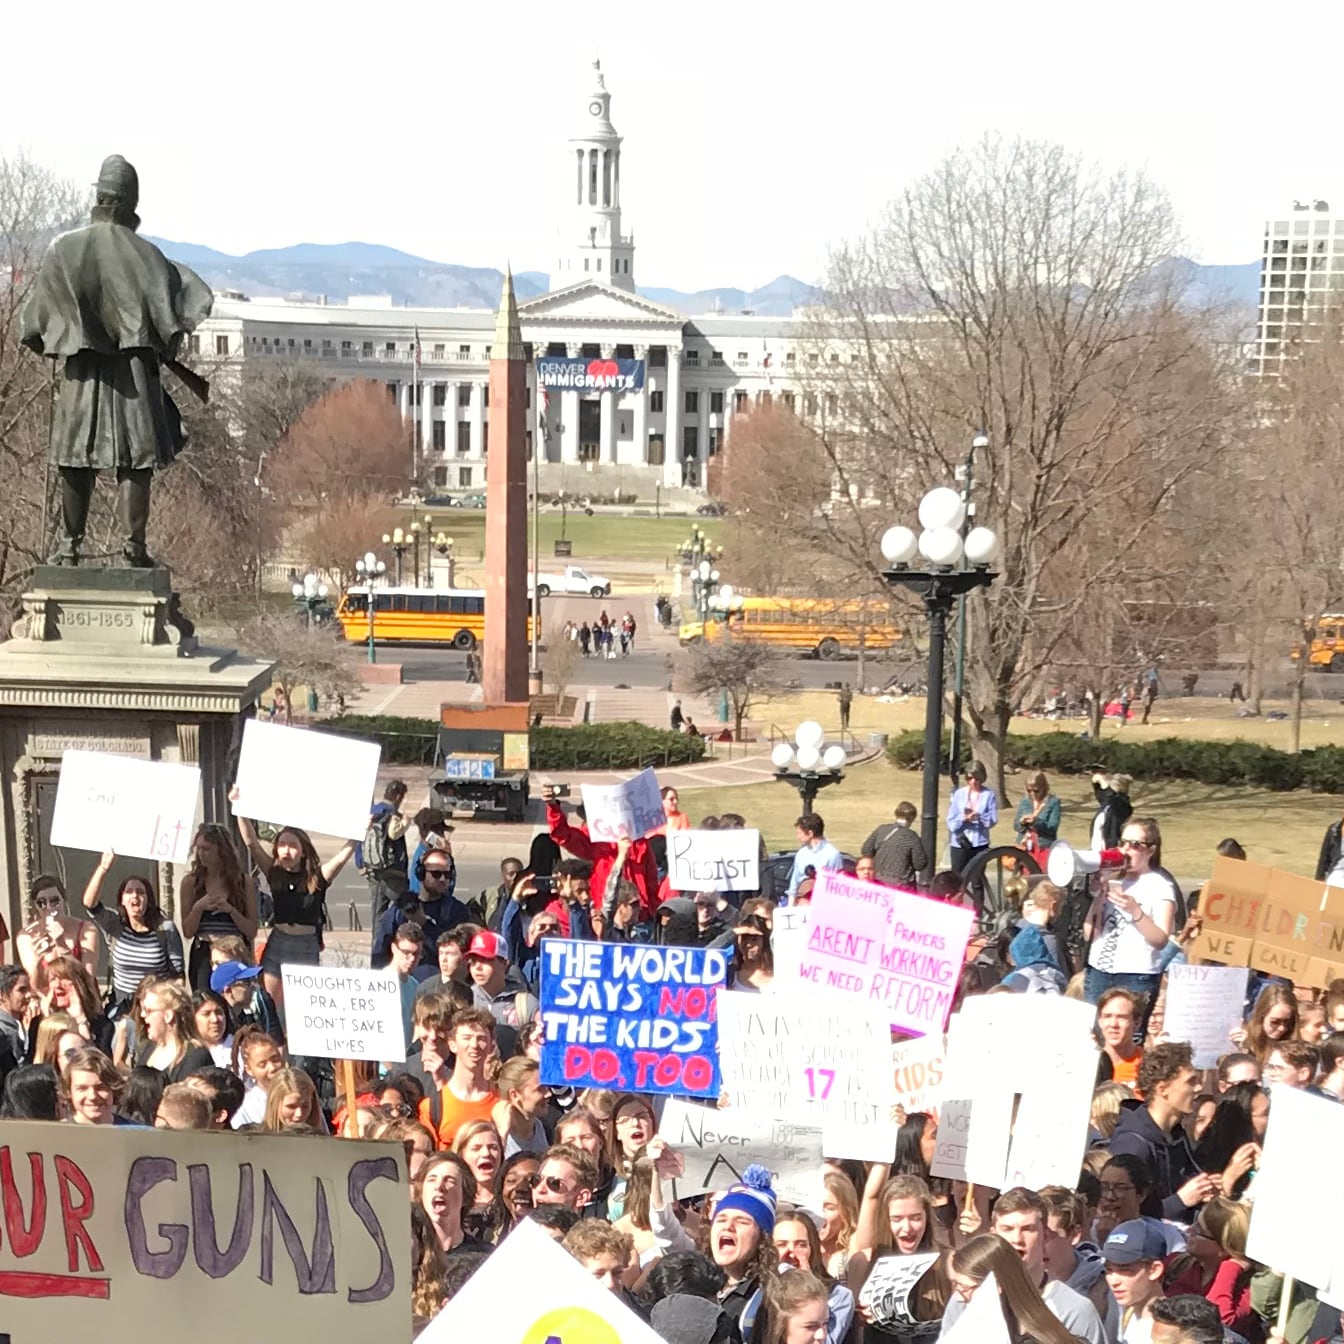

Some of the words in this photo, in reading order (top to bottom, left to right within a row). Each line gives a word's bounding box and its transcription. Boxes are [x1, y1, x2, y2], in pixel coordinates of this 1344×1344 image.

[539, 373, 635, 388] IMMIGRANTS
[540, 362, 586, 375] DENVER
[60, 611, 134, 628] 1861-1865
[673, 835, 751, 881] RESIST
[824, 875, 890, 908] THOUGHTS
[894, 921, 946, 951] PRAYERS
[544, 941, 604, 978] THE
[612, 945, 727, 985] WORLD
[880, 942, 953, 982] WORKING
[1207, 936, 1235, 956] WE
[1259, 949, 1298, 973] CALL
[286, 974, 361, 992] THOUGHTS
[368, 980, 397, 994] AND
[554, 977, 643, 1012] SAYS
[800, 962, 823, 984] WE
[826, 969, 864, 993] NEED
[869, 972, 948, 1024] REFORM
[304, 1015, 347, 1031] DON'T
[352, 1018, 385, 1034] SAVE
[543, 1011, 607, 1044] THE
[616, 1018, 711, 1053] KIDS
[564, 1044, 627, 1088] DO,
[633, 1050, 713, 1091] TOO
[803, 1066, 837, 1101] 17
[680, 1110, 752, 1149] Never
[124, 1154, 399, 1305] GUNS
